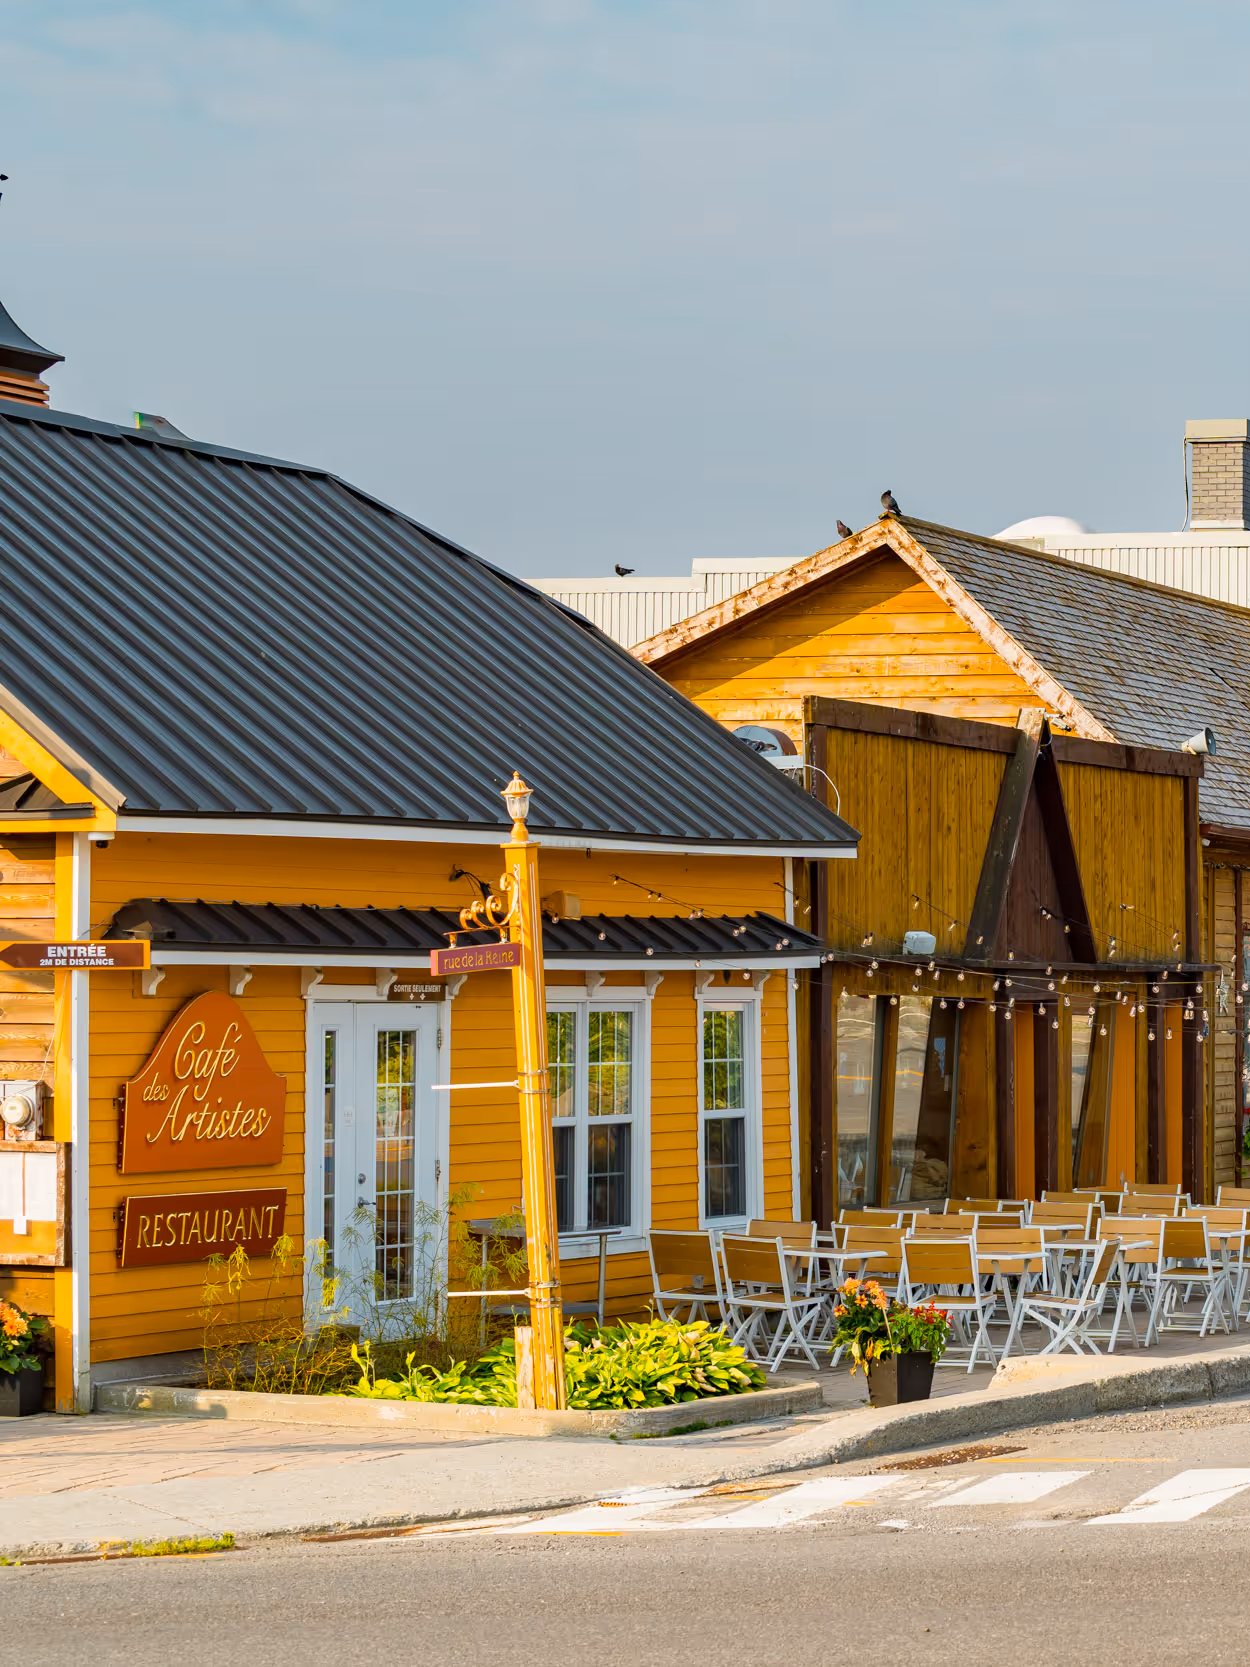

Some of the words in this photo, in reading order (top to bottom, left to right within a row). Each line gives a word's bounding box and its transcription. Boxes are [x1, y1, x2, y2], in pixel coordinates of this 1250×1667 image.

[40, 958, 53, 966] 2M
[55, 958, 67, 966] DE
[69, 958, 114, 966] DISTANCE
[47, 944, 107, 957] ENTRÉE
[444, 957, 462, 969] rue
[462, 952, 474, 967] de
[475, 951, 484, 966] la
[485, 950, 514, 965] Reine
[394, 984, 411, 992] SORTIE
[412, 984, 441, 992] SEULEMENT
[174, 1020, 243, 1101] Café
[143, 1072, 170, 1101] des
[146, 1085, 272, 1143] Artistes
[136, 1204, 280, 1249] RESTAURANT
